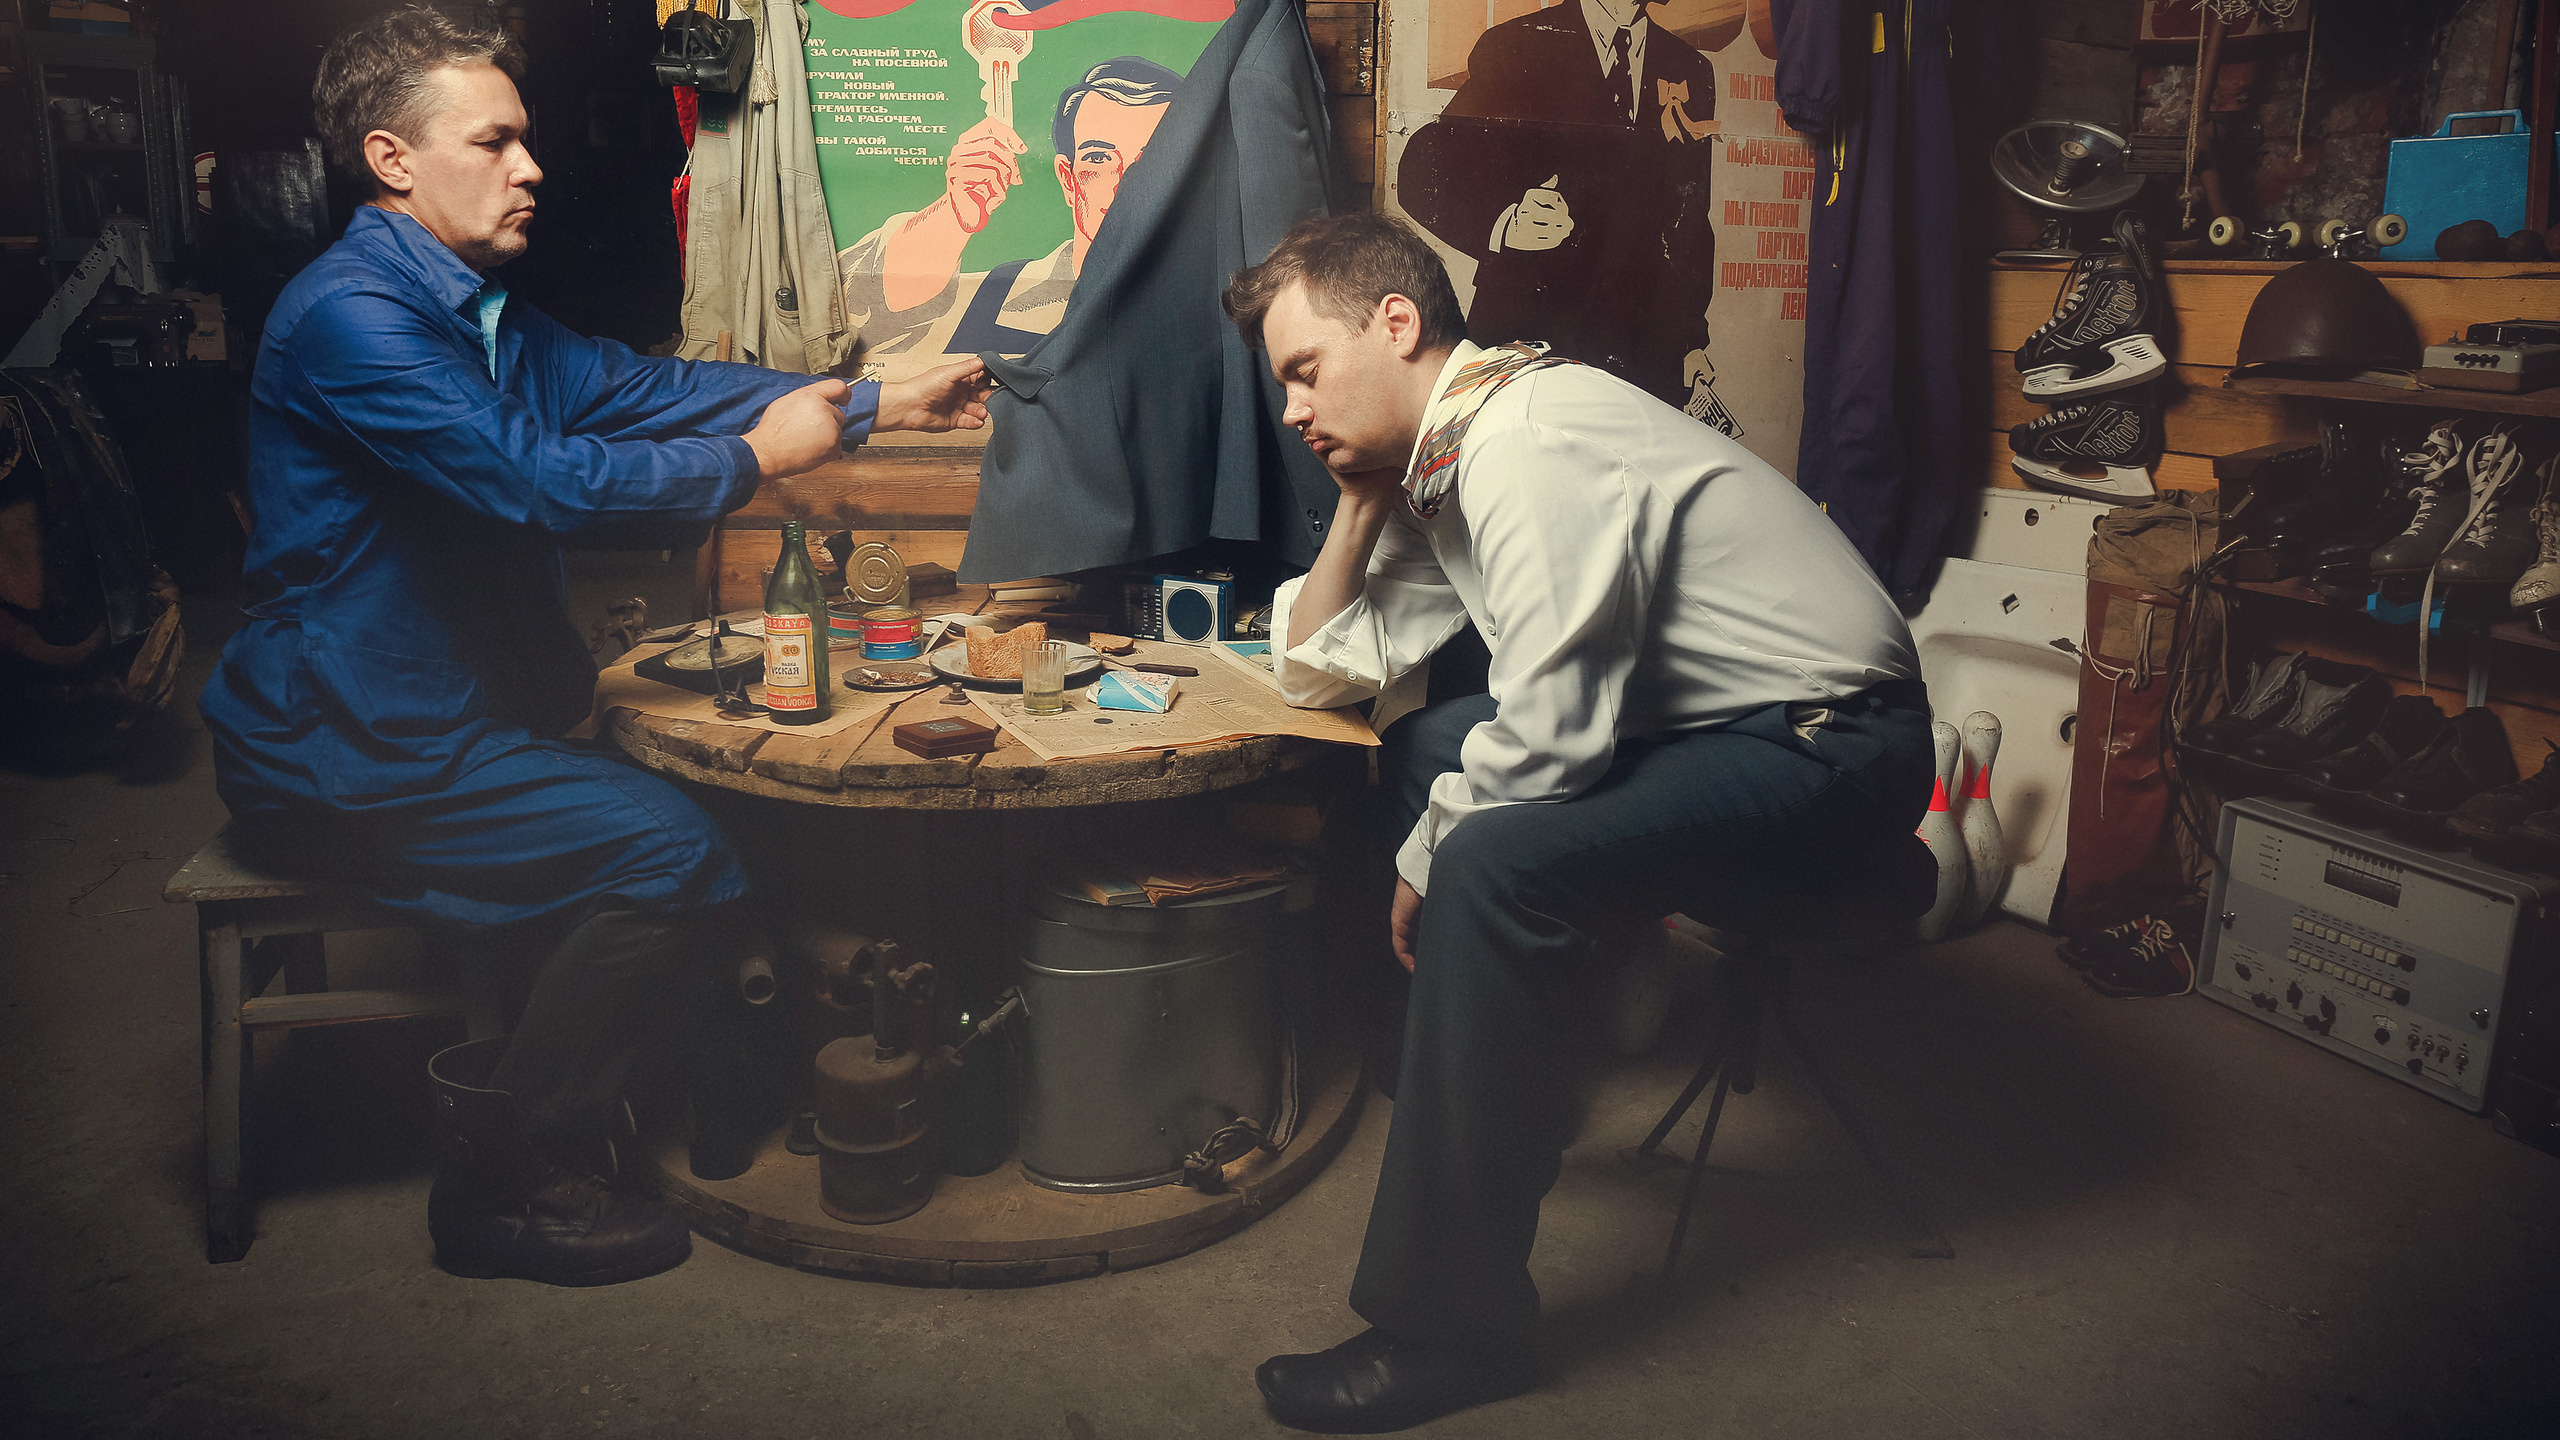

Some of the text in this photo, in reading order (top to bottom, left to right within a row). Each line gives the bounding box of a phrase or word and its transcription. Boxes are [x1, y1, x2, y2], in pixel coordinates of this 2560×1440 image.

[810, 46, 938, 58] ЗА СЛАВНЫЙ ТРУД
[852, 58, 948, 68] НА ПОСЕВНОЙ
[843, 80, 896, 90] НОВЫЙ
[1729, 72, 1752, 100] МЫ
[816, 91, 949, 101] ТРАКТОР ИМЕННОЙ.
[834, 115, 923, 123] НА РАБОЧЕМ
[902, 125, 948, 133] МЕСТЕ
[815, 135, 887, 145] ВЫ ТАКОЙ
[855, 147, 928, 156] ДОБИТЬСЯ
[893, 155, 945, 165] ЧЕСТИ!
[1723, 200, 1800, 228] МЫ ГОВОРИМ
[1756, 231, 1808, 262] ПАРТИЯ,
[2076, 278, 2137, 343] Detroit
[787, 697, 813, 707] VODKA
